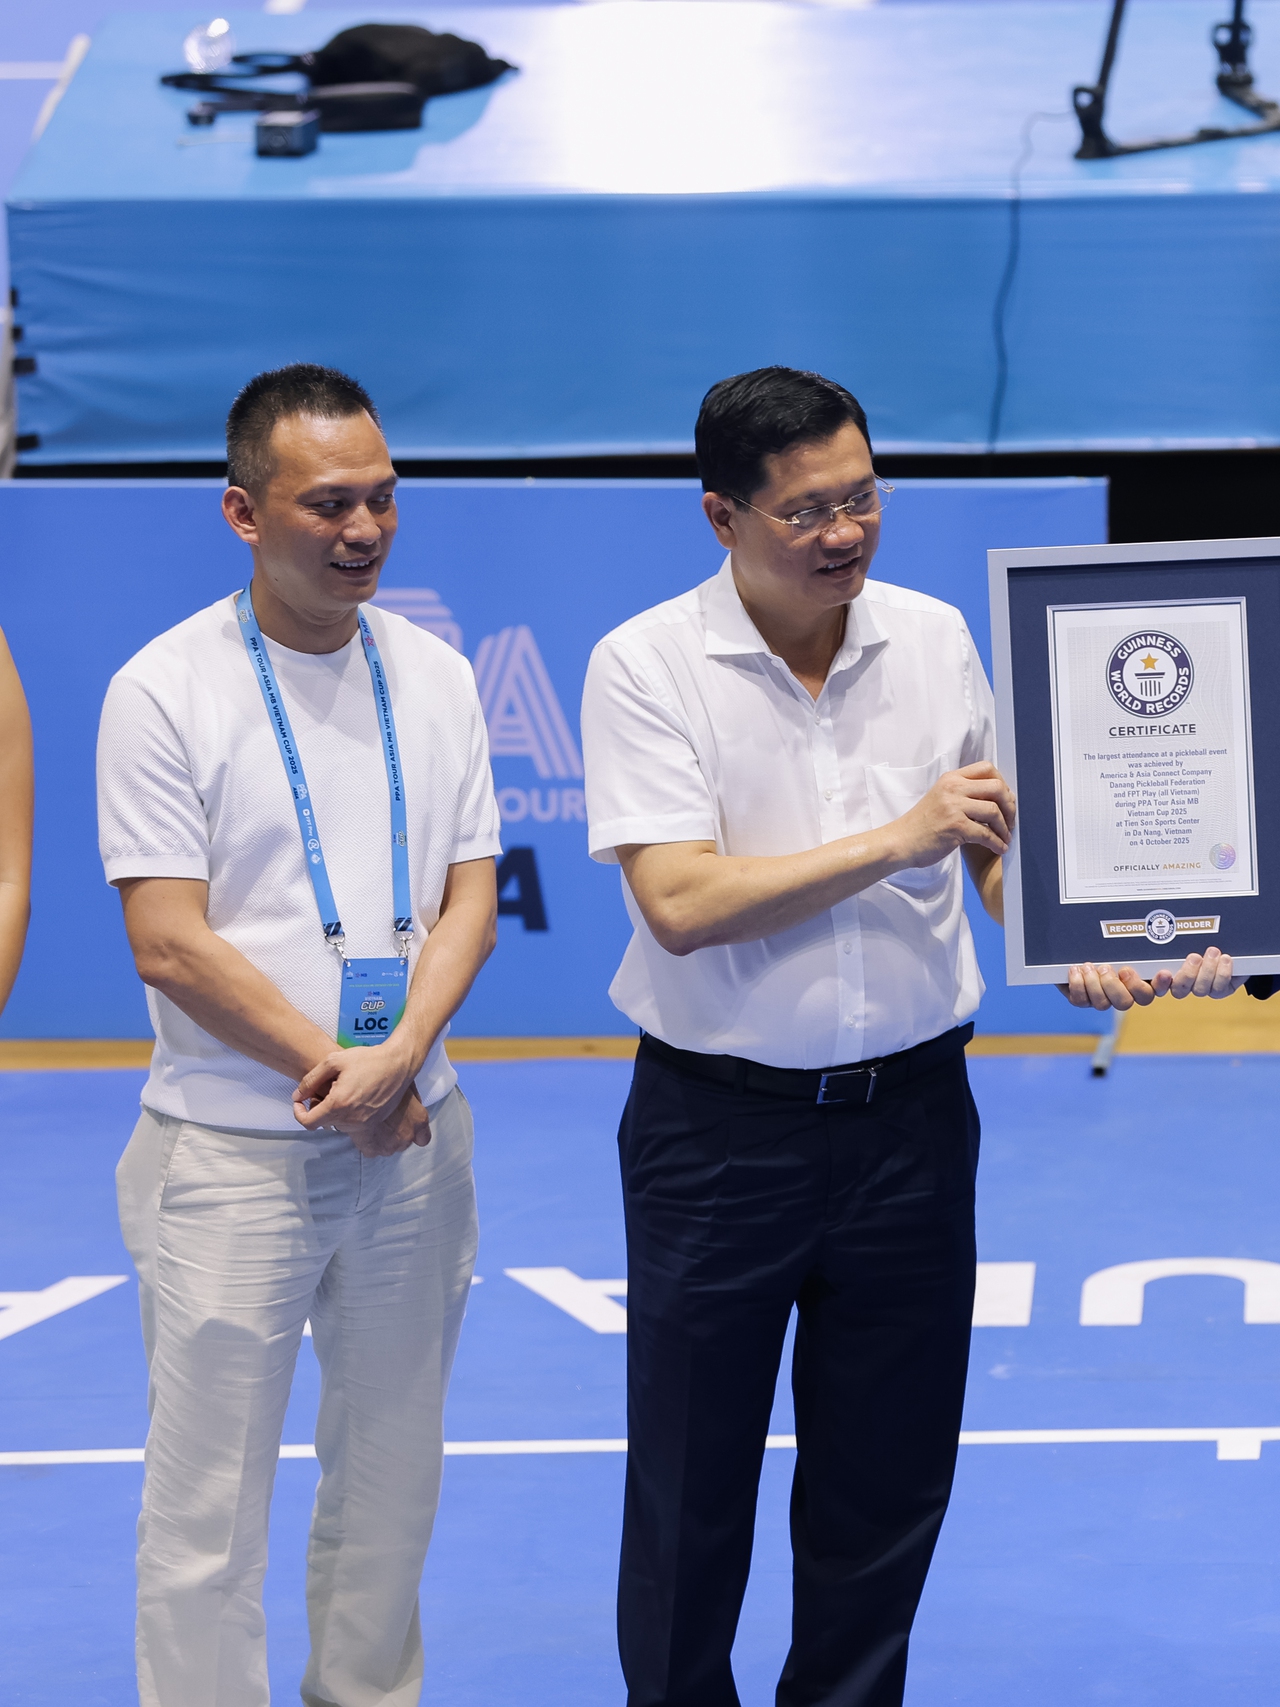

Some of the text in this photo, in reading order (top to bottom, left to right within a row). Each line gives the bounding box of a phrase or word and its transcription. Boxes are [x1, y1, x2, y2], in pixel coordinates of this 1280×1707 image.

[1118, 636, 1181, 660] GUINNESS
[373, 660, 382, 679] 2025
[1111, 667, 1189, 713] WORLD RECORDS
[250, 637, 299, 775] PPA TOUR ASIA MB VIETNAM CUP 2025
[381, 696, 392, 730] VIETNAM
[1109, 724, 1196, 736] CERTIFICATE
[1097, 753, 1120, 761] largest
[1175, 749, 1207, 758] pickleball
[391, 763, 399, 784] TOUR
[393, 785, 401, 801] PPA
[1158, 789, 1168, 797] (all
[498, 787, 588, 823] OUR
[1156, 809, 1169, 817] Cup
[1114, 862, 1201, 872] OFFICIALLY AMAZING
[1110, 921, 1211, 932] RECORD HOLDER
[361, 1001, 385, 1011] CUP
[354, 1017, 388, 1030] LOC
